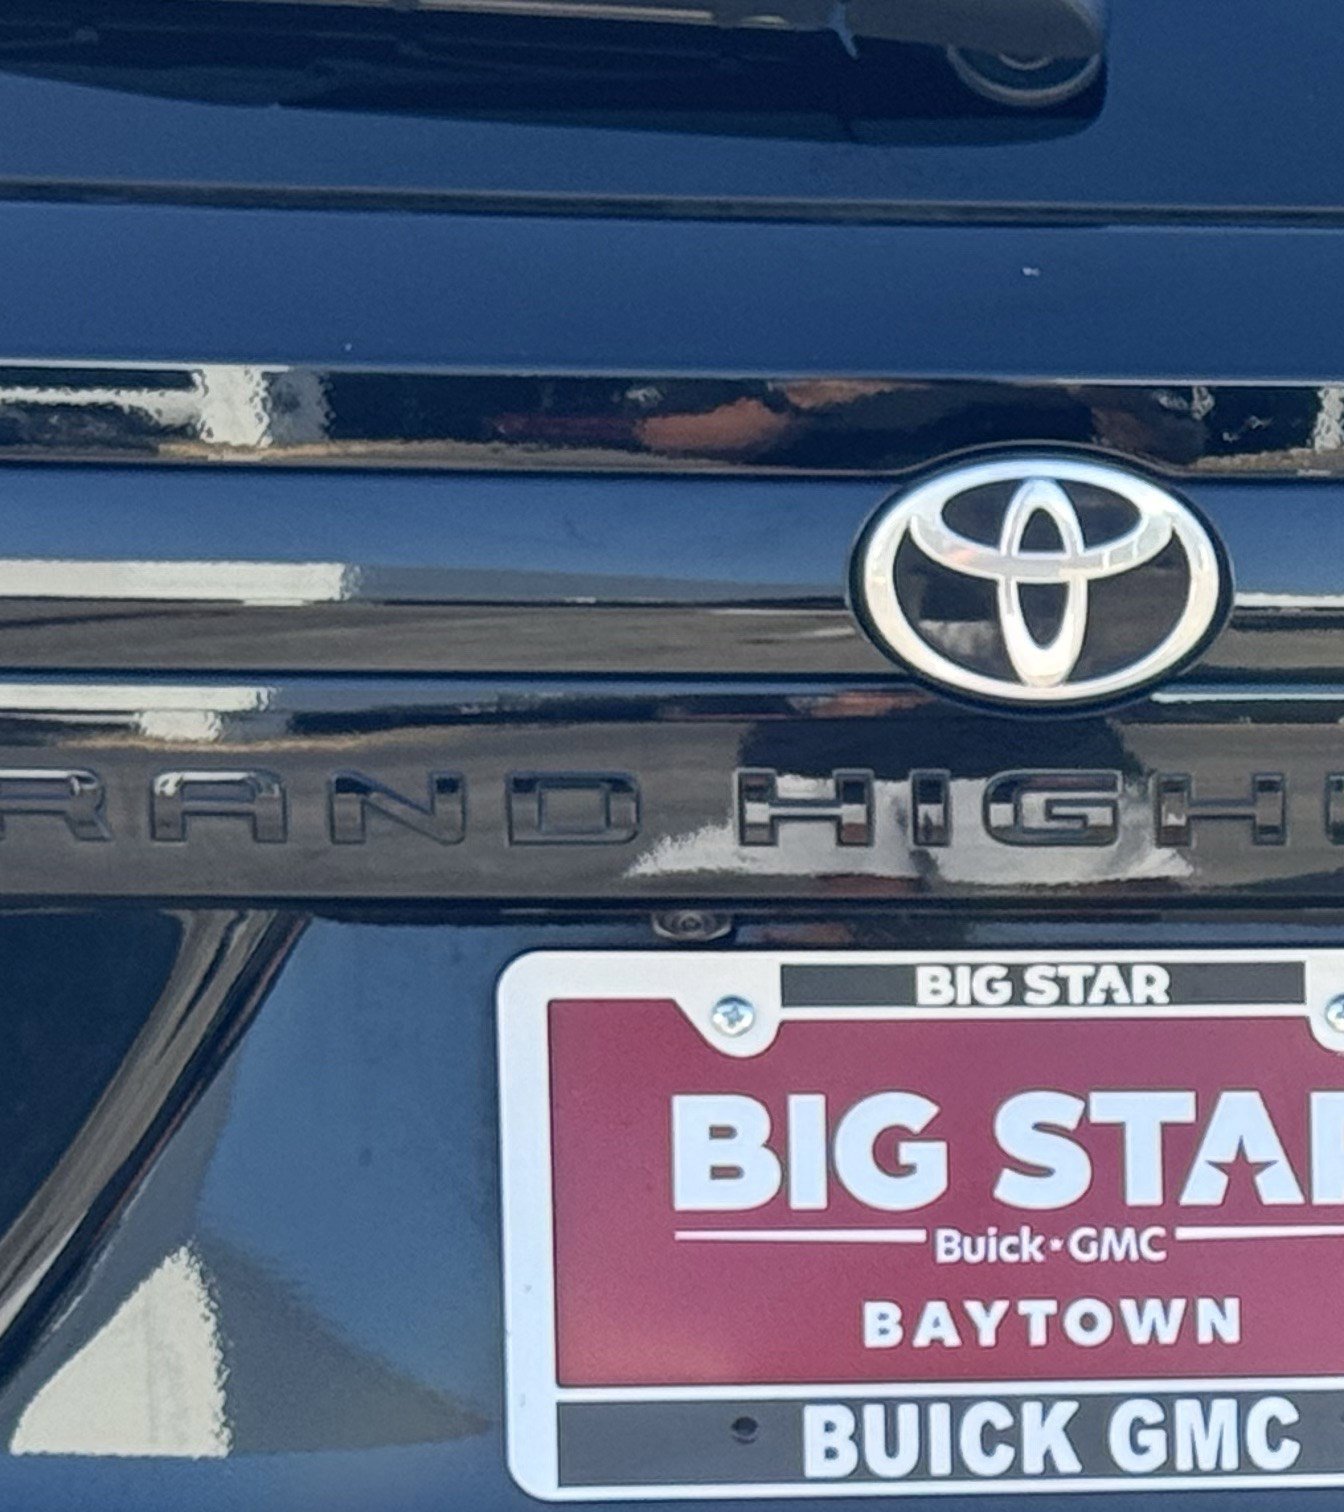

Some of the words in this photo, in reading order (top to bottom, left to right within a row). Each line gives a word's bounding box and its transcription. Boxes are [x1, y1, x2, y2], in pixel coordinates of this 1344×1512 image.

[915, 965, 1013, 1006] BIG
[1024, 963, 1171, 1005] STAR
[671, 1091, 948, 1211] BIG
[935, 1226, 1044, 1263] Buick
[1068, 1226, 1167, 1263] GMC
[863, 1297, 1241, 1348] BAYTOWN
[803, 1400, 1081, 1477] BUICK
[1108, 1397, 1302, 1473] GMC
